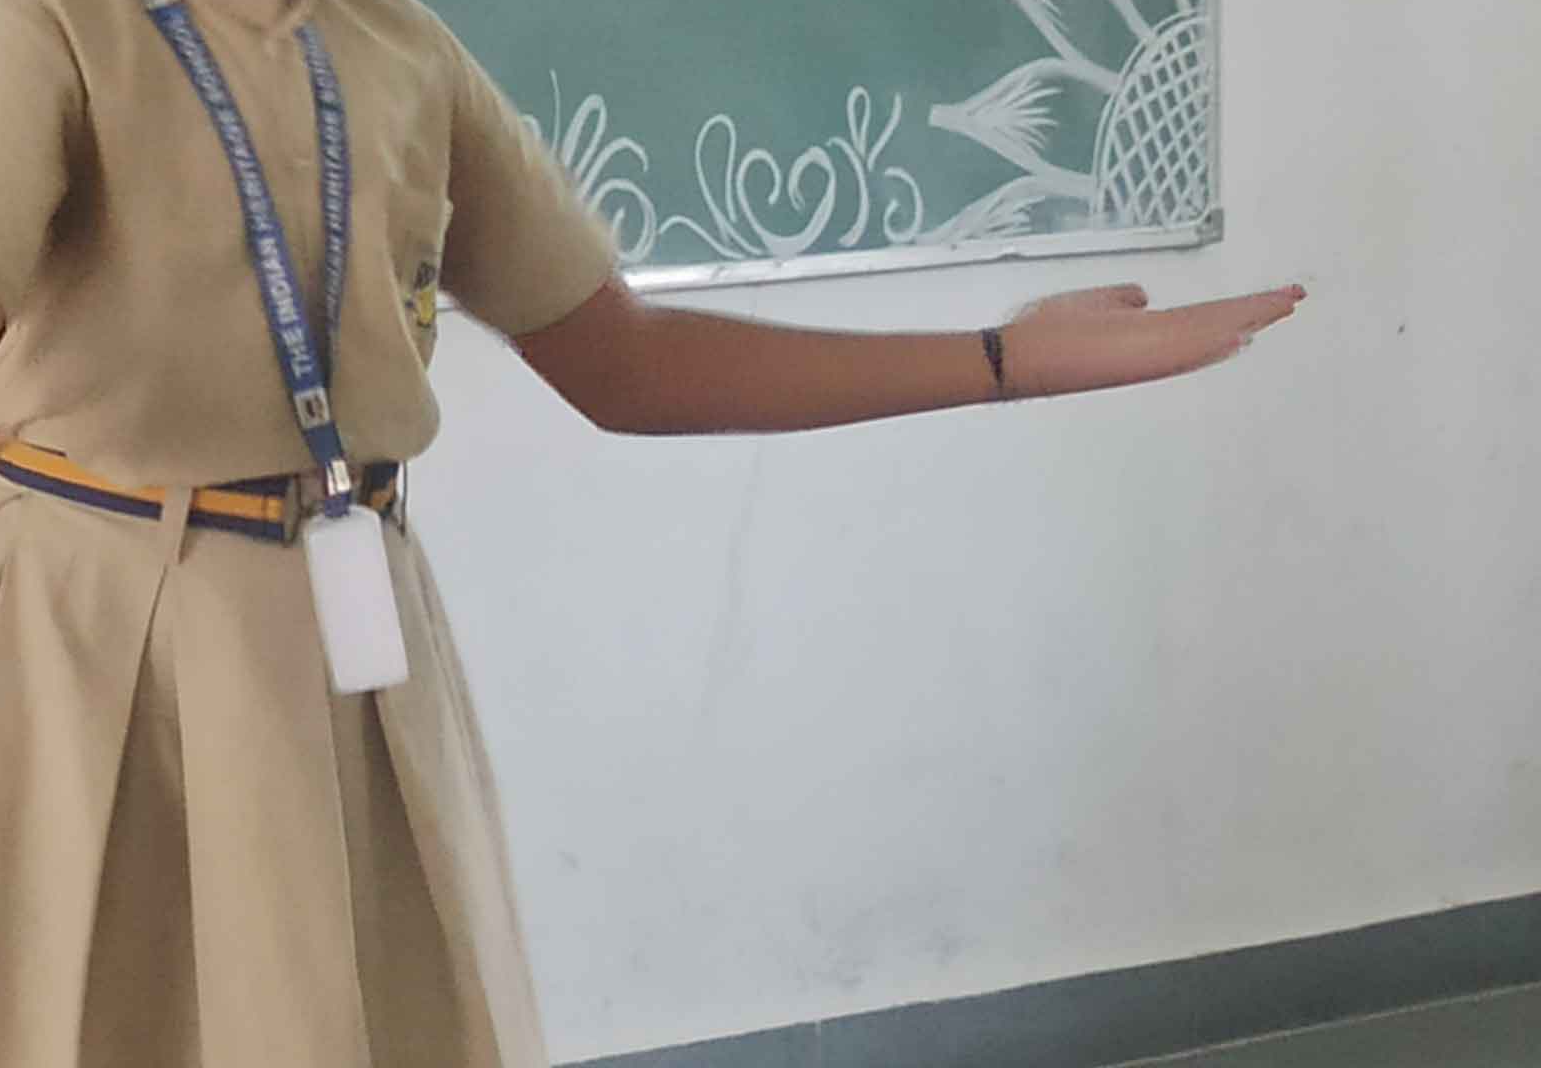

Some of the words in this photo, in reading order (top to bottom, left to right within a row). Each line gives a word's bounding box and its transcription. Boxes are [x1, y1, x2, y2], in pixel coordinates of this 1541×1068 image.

[216, 106, 274, 232] HERITAGE
[258, 236, 300, 323] INDIAN
[283, 326, 314, 378] THE
